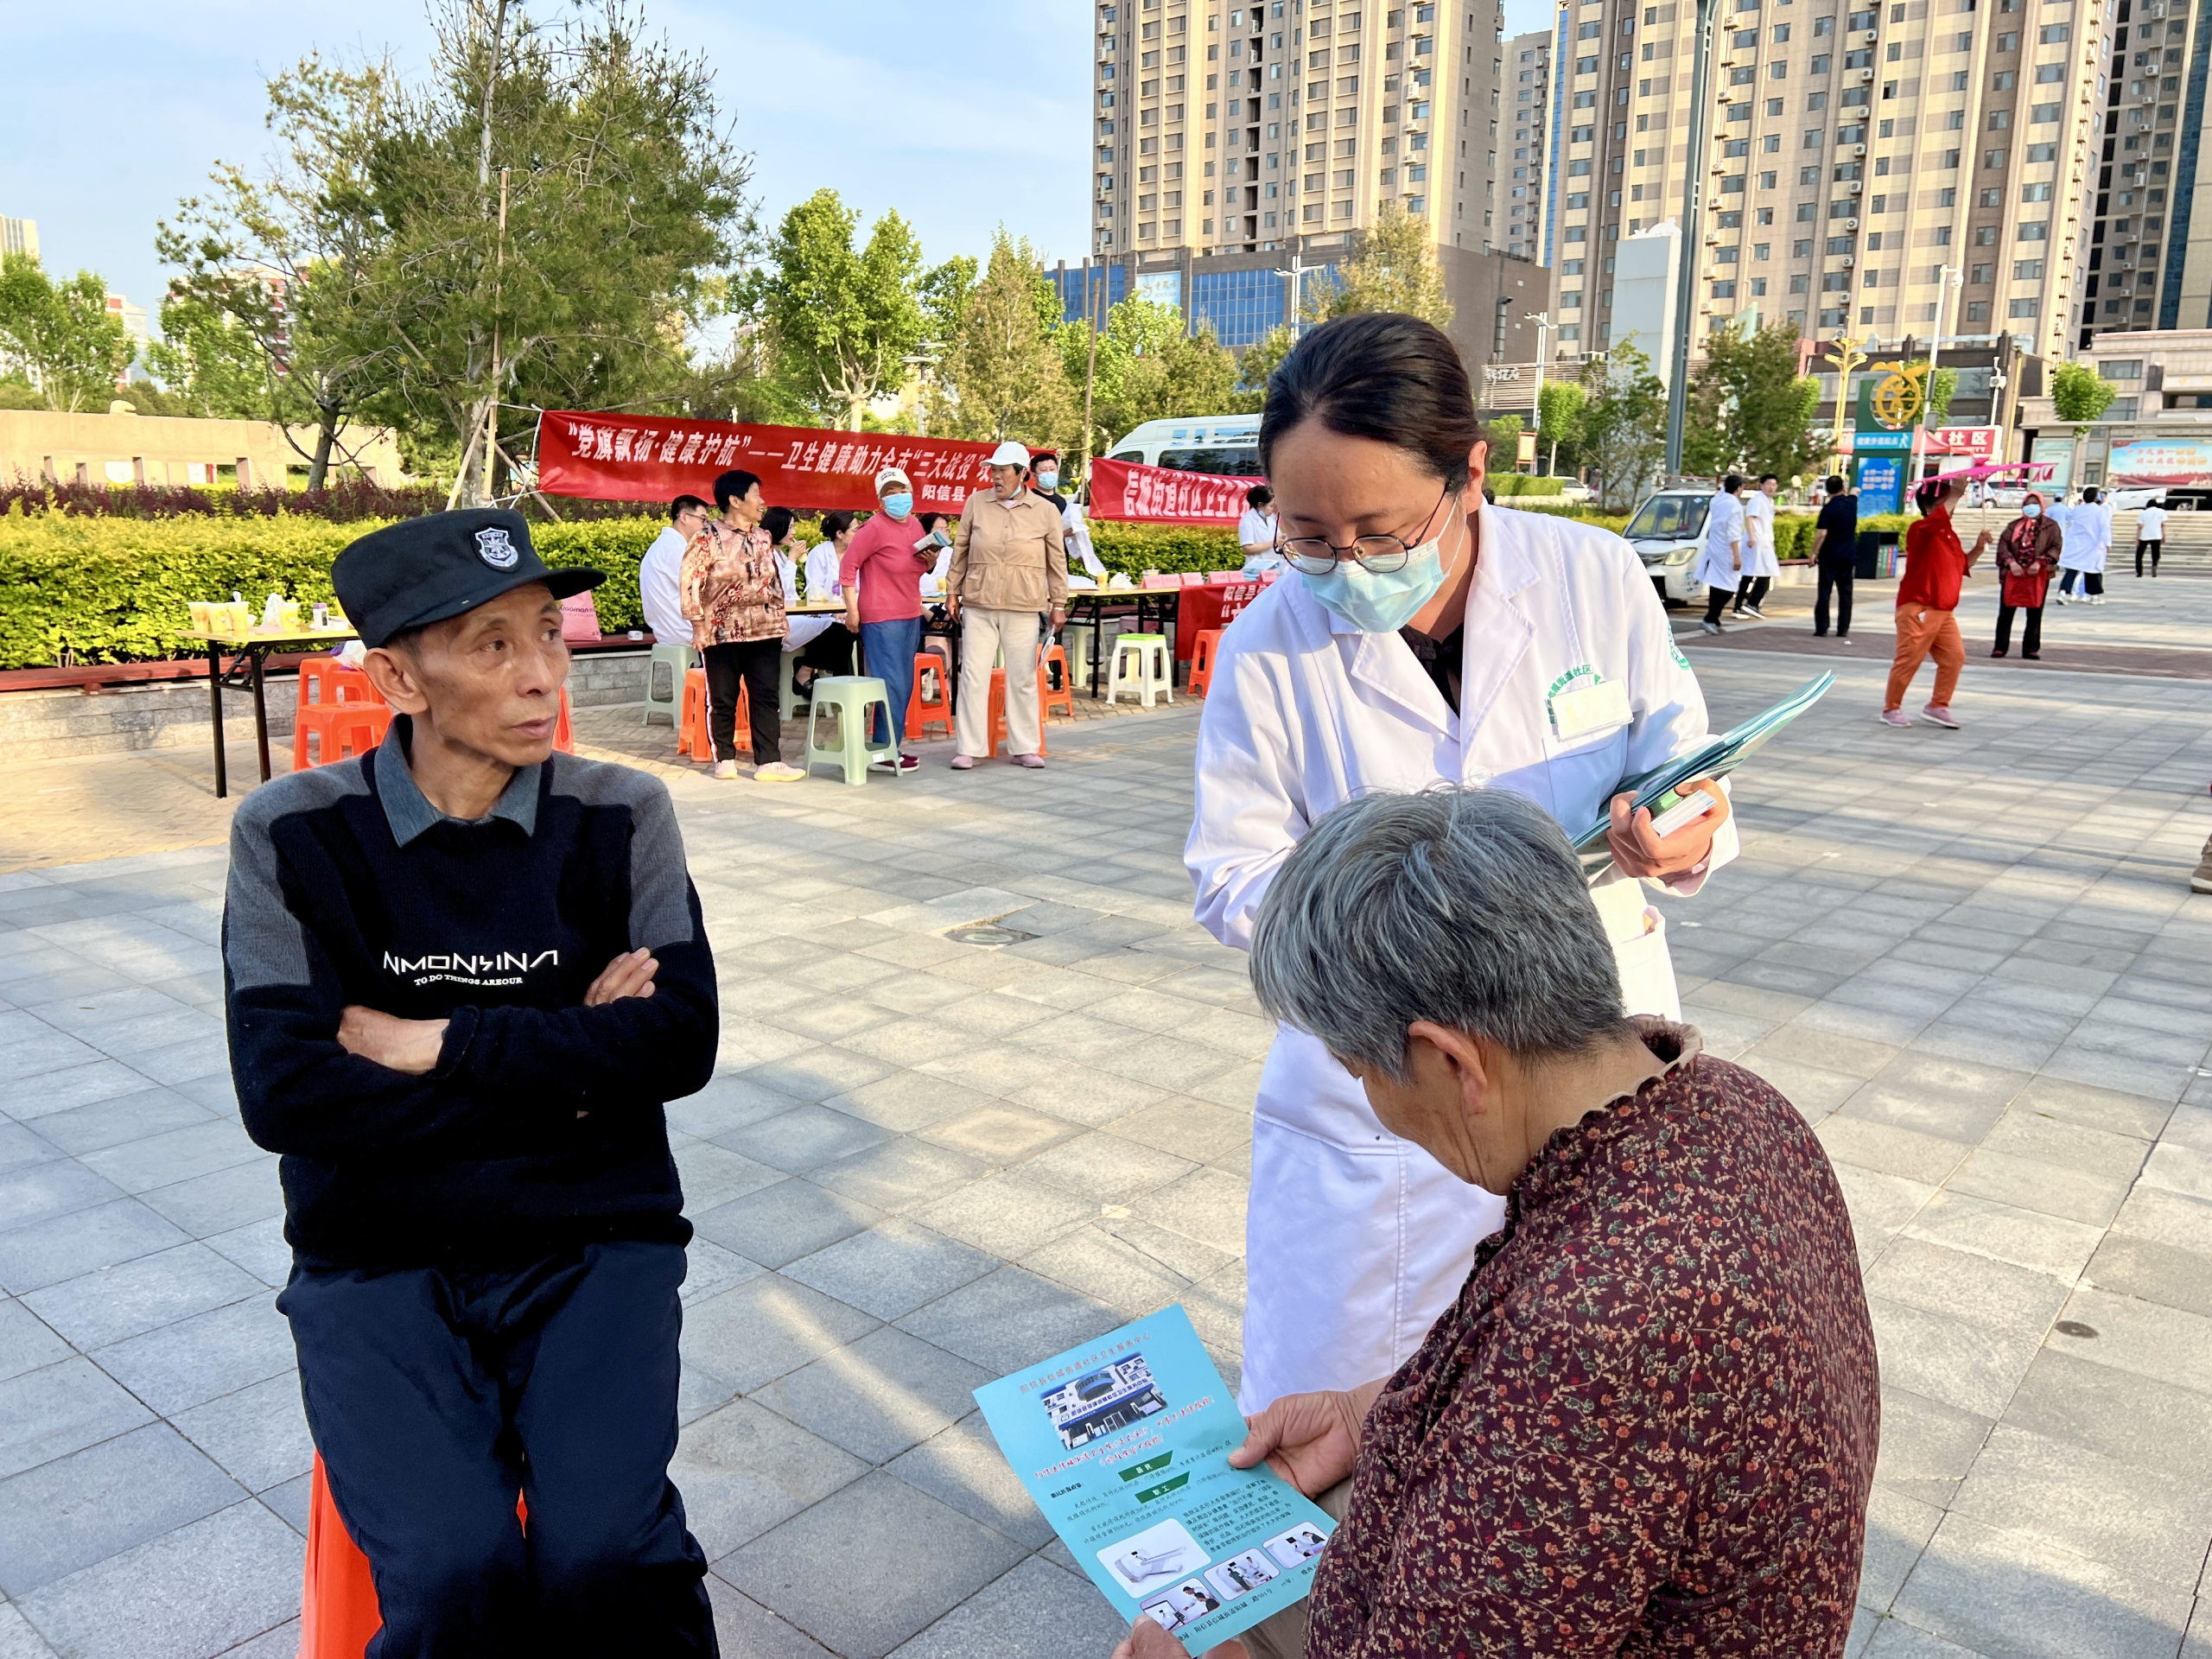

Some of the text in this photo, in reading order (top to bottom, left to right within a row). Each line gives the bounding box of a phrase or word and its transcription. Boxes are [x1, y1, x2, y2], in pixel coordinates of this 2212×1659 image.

[569, 422, 993, 482] “党旗飘扬·健康护航”——卫生健康助力全市“三大战役”攻
[921, 484, 976, 501] 阳信县
[1122, 467, 1264, 518] 信城街道社区卫生服务
[414, 976, 428, 986] TO
[429, 974, 443, 982] DO
[443, 974, 480, 985] THINGS
[1152, 1484, 1170, 1497] 职工
